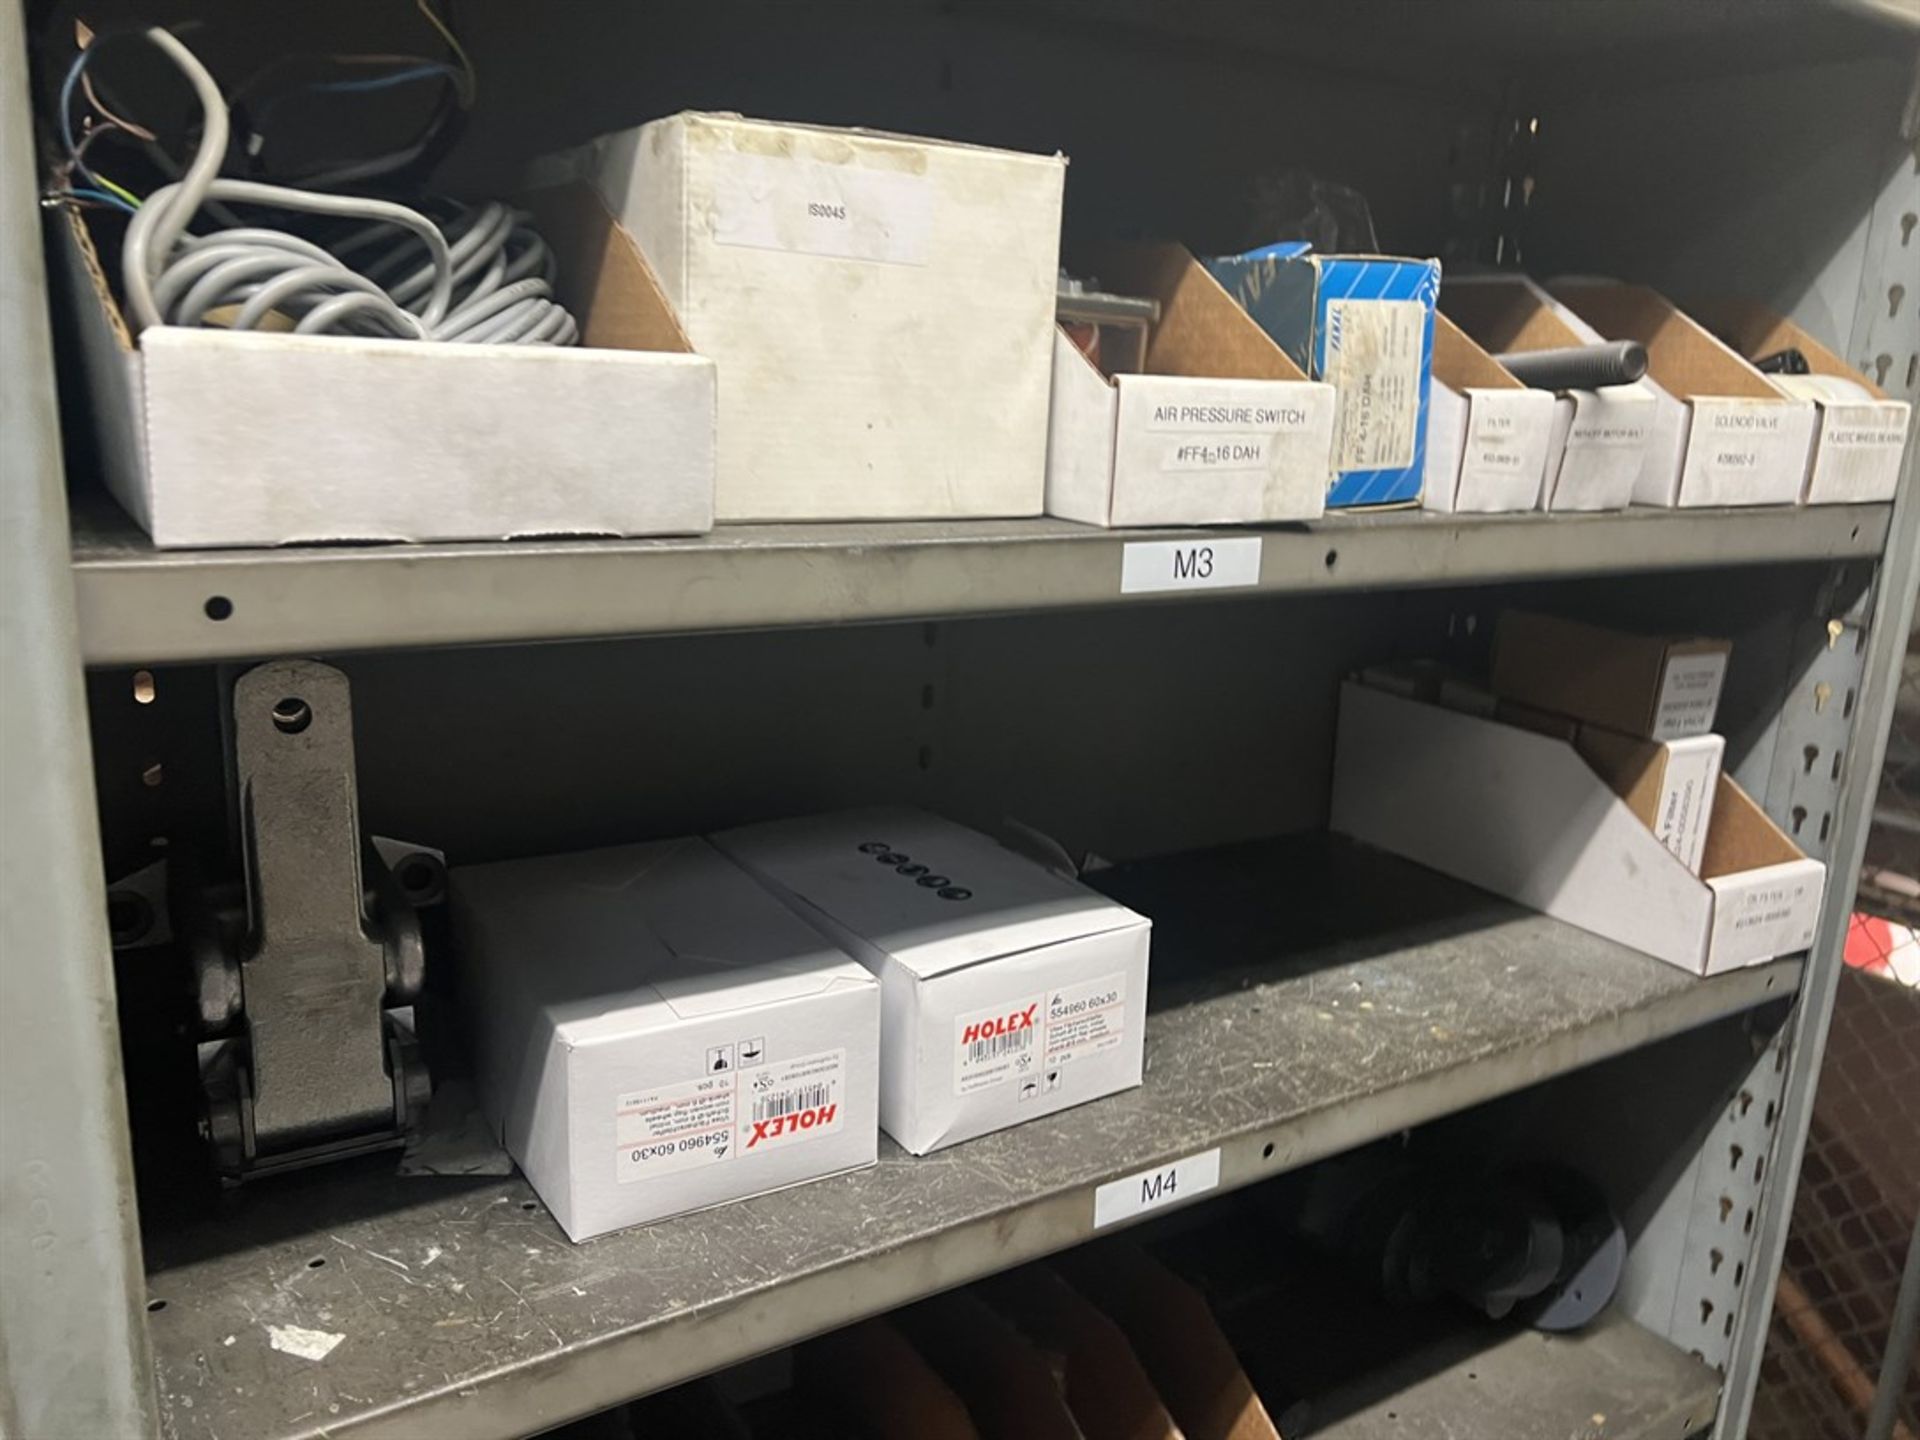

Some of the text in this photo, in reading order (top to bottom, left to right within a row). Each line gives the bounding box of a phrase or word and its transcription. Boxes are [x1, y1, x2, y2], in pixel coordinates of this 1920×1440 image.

[1154, 406, 1305, 424] AIR PRESSURE SWITCH
[1232, 445, 1260, 460] DAH
[1173, 547, 1214, 579] M3
[1050, 991, 1118, 1019] 554960 60x30
[961, 1003, 1037, 1045] HOLEX
[746, 1103, 837, 1149] HOLEX
[631, 1130, 729, 1163] 554960 60x30
[1141, 1168, 1177, 1203] M4
